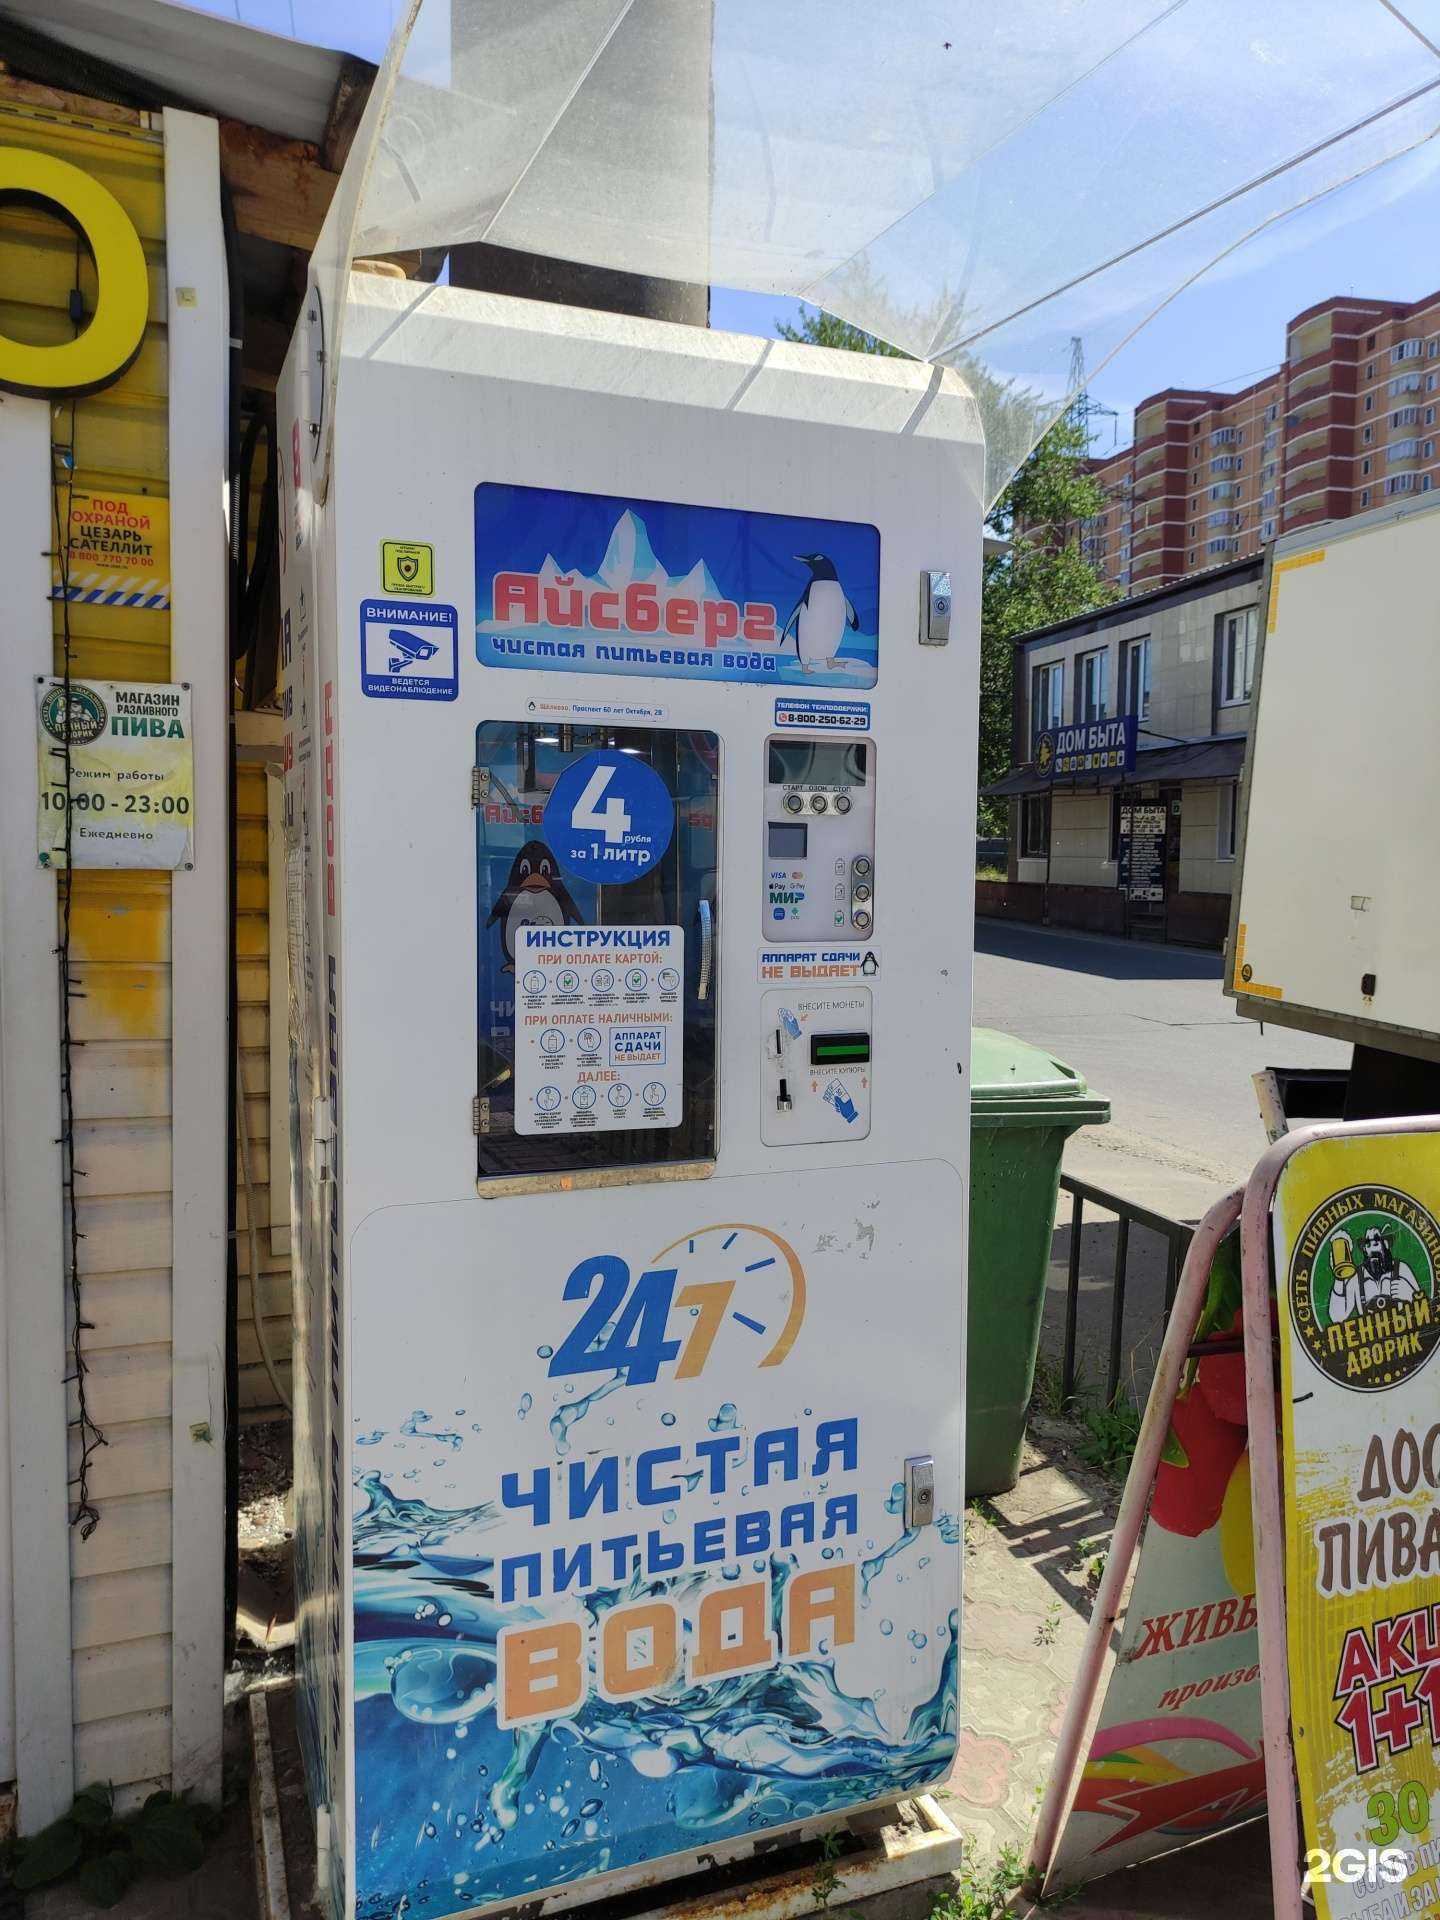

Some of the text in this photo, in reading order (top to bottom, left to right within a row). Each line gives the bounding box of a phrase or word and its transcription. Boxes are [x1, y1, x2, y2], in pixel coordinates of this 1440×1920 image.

[92, 499, 128, 515] ПОД
[72, 511, 151, 530] ОХРАНОЙ
[80, 525, 142, 542] ЦЕЗАРЬ
[70, 538, 152, 556] САТЕЛЛИТ
[126, 555, 138, 565] 70
[141, 557, 154, 567] 00
[366, 607, 452, 623] ВНИМАНИЕ!
[494, 571, 777, 648] Айсберг
[492, 636, 776, 672] чистая питьевая вода
[368, 684, 453, 695] ВИДЕОНАБЛЮДЕНИЕ
[391, 677, 430, 686] ВЕДЕТСЯ
[116, 691, 180, 706] МАГАЗИН
[117, 704, 178, 717] РАЗЛИВНОГО
[111, 716, 185, 739] ПИВА
[788, 714, 866, 725] 8-800-250-62-29
[1056, 722, 1126, 754] ДОМ БЫТА
[69, 767, 164, 781] Режим работы
[124, 795, 189, 814] 23:00
[571, 765, 631, 843] 4
[79, 827, 153, 840] Ежедневно
[624, 834, 651, 844] рубля
[570, 843, 651, 866] за 1 литр
[770, 892, 805, 903] МИР
[527, 930, 671, 949] ИНСТРУКЦИЯ
[538, 953, 663, 964] ПРИ ОПЛАТЕ КАРТОЙ:
[762, 952, 860, 963] АППАРАТ СДАЧИ
[762, 964, 860, 978] НЕ ВЫДАЕТ
[798, 1000, 865, 1010] ВНЕСИТЕ МОНЕТЫ
[525, 1013, 673, 1026] ПРИ ОПЛАТЕ НАЛИЧНЫМИ:
[614, 1031, 662, 1041] АППАРАТ
[614, 1042, 662, 1053] СДАЧИ
[614, 1053, 661, 1062] НЕ ВЫДАЕТ
[577, 1071, 620, 1083] ДАЛЕЕ:
[1301, 1193, 1365, 1258] ПИВНЫХ
[1296, 1269, 1312, 1322] СЕТЬ
[1327, 1292, 1431, 1353] ПЕННЫЙ
[1347, 1331, 1423, 1377] ДВОРИК
[501, 1417, 858, 1527] ЧИСТАЯ
[501, 1493, 858, 1604] ПИТЬЕВАЯ
[1319, 1507, 1440, 1591] ПИВА
[503, 1563, 857, 1723] ВОДА
[1157, 1664, 1261, 1711] произв
[1334, 1664, 1440, 1775] 1+1
[1367, 1780, 1430, 1846] 30
